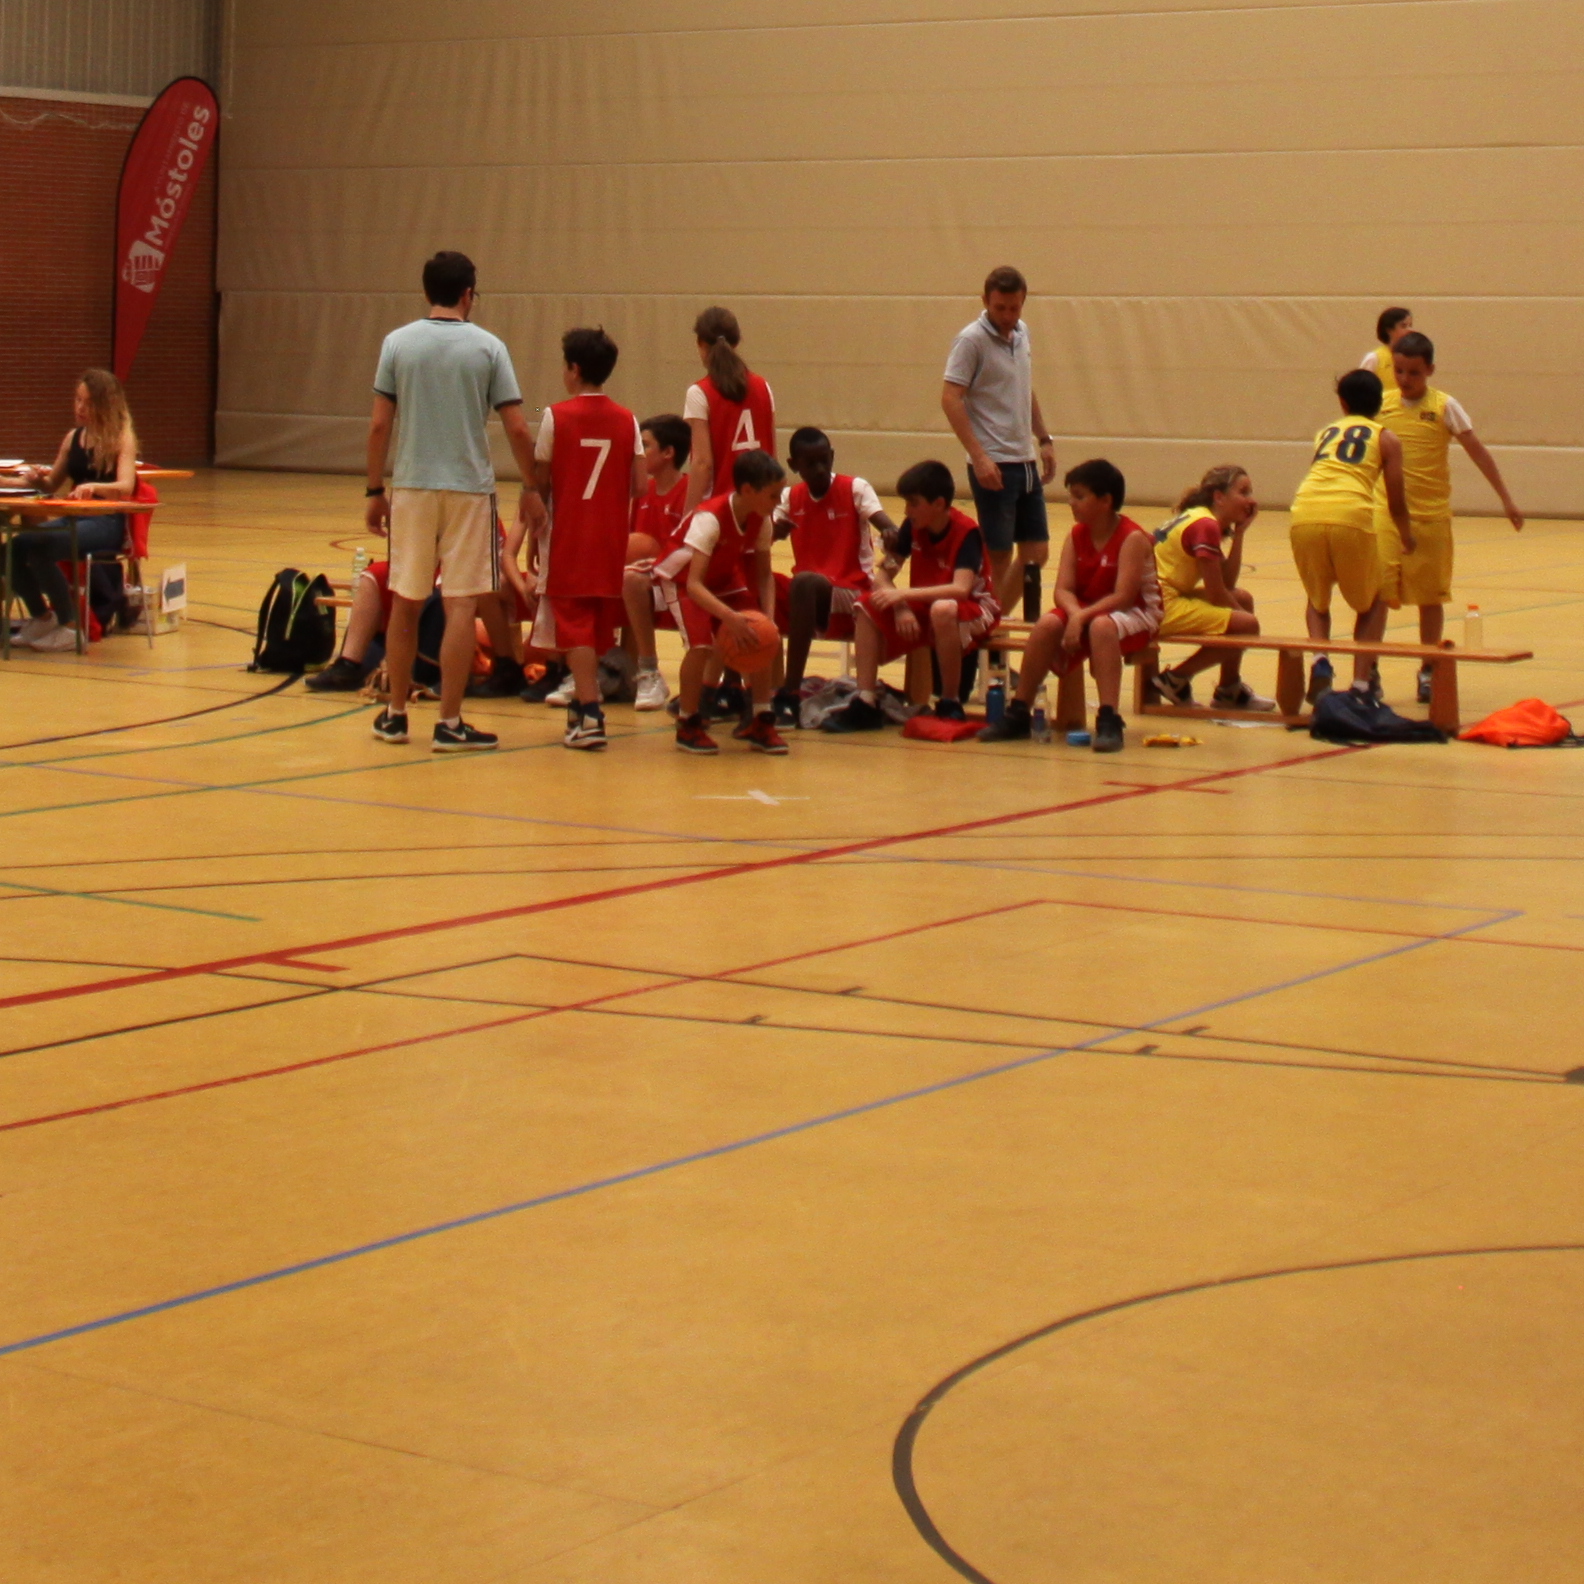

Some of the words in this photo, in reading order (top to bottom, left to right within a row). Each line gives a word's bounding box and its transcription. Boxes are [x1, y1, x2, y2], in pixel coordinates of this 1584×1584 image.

[144, 105, 211, 246] Móstoles
[731, 409, 761, 452] 4
[1313, 425, 1373, 464] 28
[580, 438, 611, 500] 7
